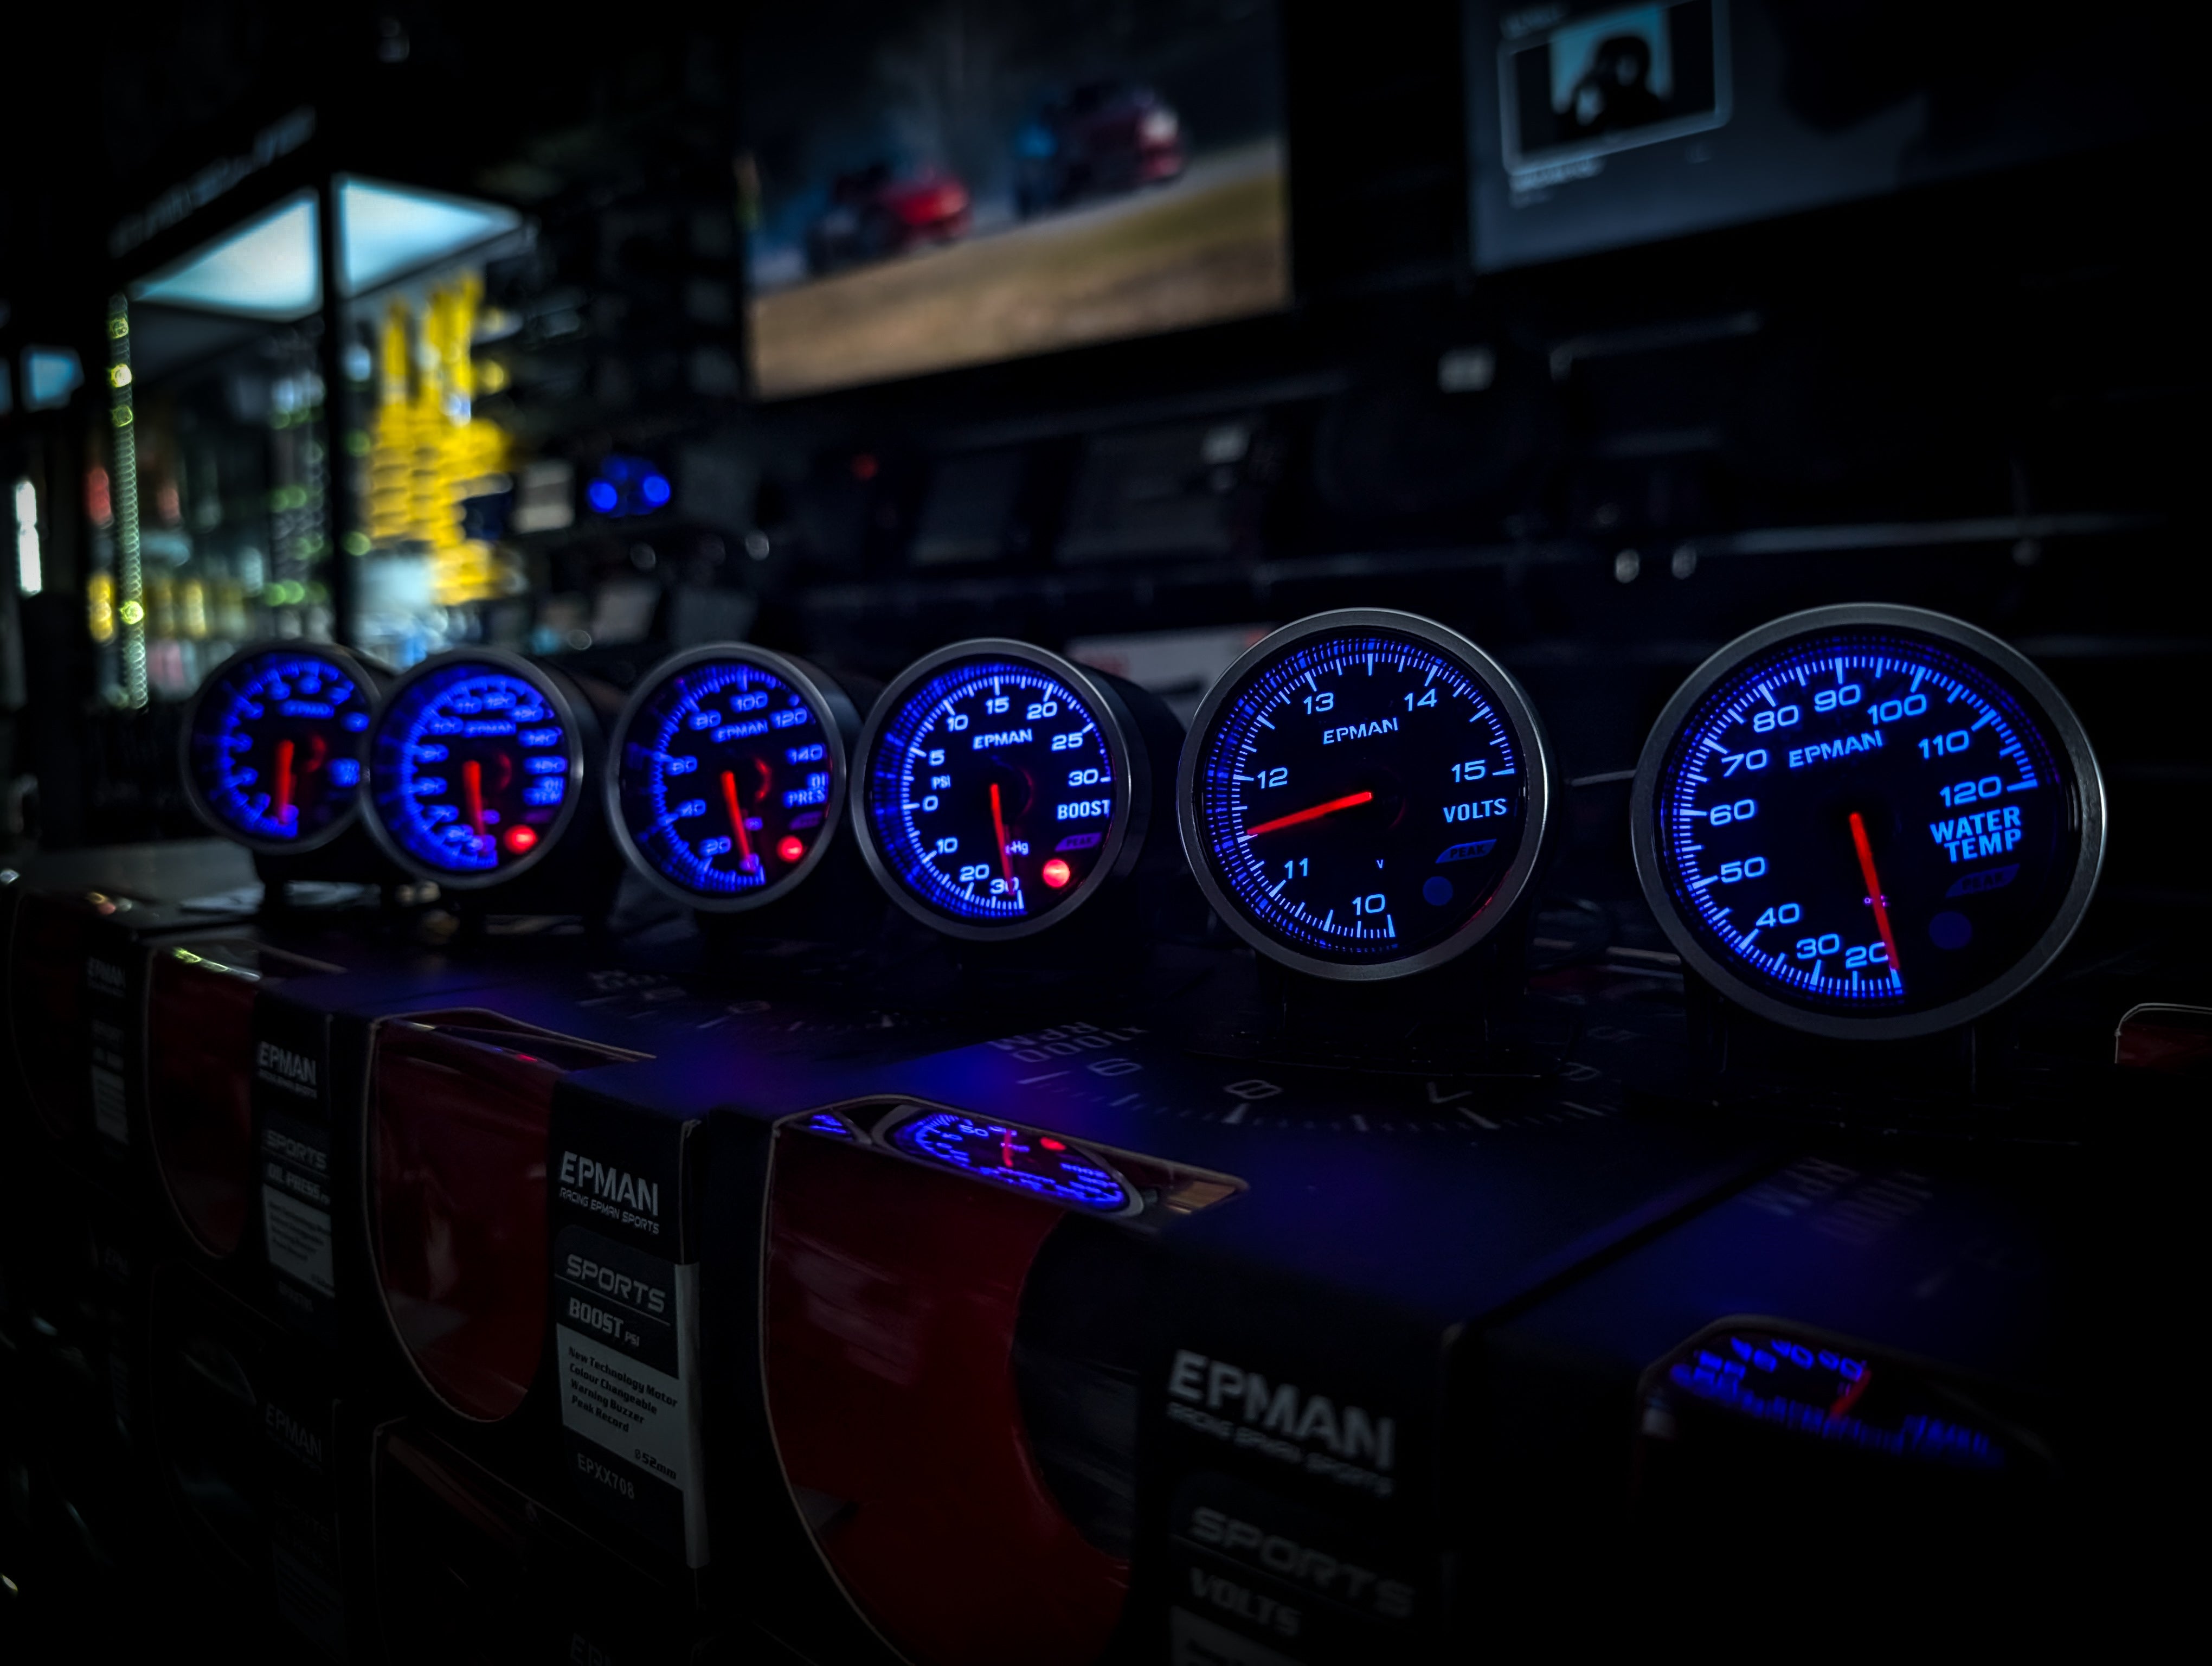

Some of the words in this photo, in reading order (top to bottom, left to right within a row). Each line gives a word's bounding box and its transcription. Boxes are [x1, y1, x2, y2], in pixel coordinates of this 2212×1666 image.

[986, 697, 1009, 714] 15
[1027, 701, 1058, 720] 20
[1303, 693, 1334, 714] 13
[1404, 689, 1437, 712] 14
[1814, 684, 1861, 712] 90
[1867, 694, 1927, 725] 100
[947, 715, 968, 731] 10
[1323, 717, 1398, 745] EPMAN
[1753, 704, 1799, 733] 80
[973, 729, 1032, 750] EPMAN
[1052, 732, 1083, 751] 25
[1789, 730, 1883, 767] EPMAN
[1918, 729, 1969, 759] 110
[929, 749, 944, 766] 5
[1721, 749, 1768, 777] 70
[932, 776, 950, 790] PSI
[1069, 769, 1098, 786] 30
[1257, 768, 1288, 789] 12
[1451, 760, 1486, 783] 15
[923, 795, 938, 811] 0
[1940, 777, 2002, 806] 120
[1057, 800, 1111, 819] BOOST
[1443, 798, 1507, 823] VOLTS
[1709, 799, 1755, 825] 60
[1930, 806, 2021, 844] WATER
[936, 837, 958, 854] 10
[1449, 844, 1484, 858] PEAK
[1944, 829, 2022, 862] TEMP
[960, 864, 989, 881] 20
[1284, 858, 1308, 879] 11
[1720, 857, 1766, 883] 50
[1352, 894, 1385, 915] 10
[1756, 903, 1800, 926] 40
[1796, 933, 1840, 959] 30
[258, 1041, 316, 1085] EPMAN
[560, 1151, 659, 1217] EPMAN
[590, 1199, 620, 1220] EPMAN
[622, 1210, 660, 1236] SPORTS
[567, 1254, 666, 1313] SPORTS
[569, 1297, 623, 1338] BOOST
[569, 1347, 588, 1363] New
[590, 1357, 645, 1393] Technology
[646, 1385, 677, 1407] Motor
[570, 1363, 598, 1384] Colour
[601, 1379, 657, 1414] Changeable
[571, 1379, 608, 1407] Warning
[610, 1399, 645, 1424] Buzzer
[572, 1394, 594, 1414] Peak
[596, 1407, 629, 1432] Record
[1167, 1349, 1397, 1471] EPMAN
[577, 1452, 635, 1500] EPXX708
[1188, 1506, 1417, 1619] SPORTS
[1189, 1566, 1303, 1637] VOLTS
